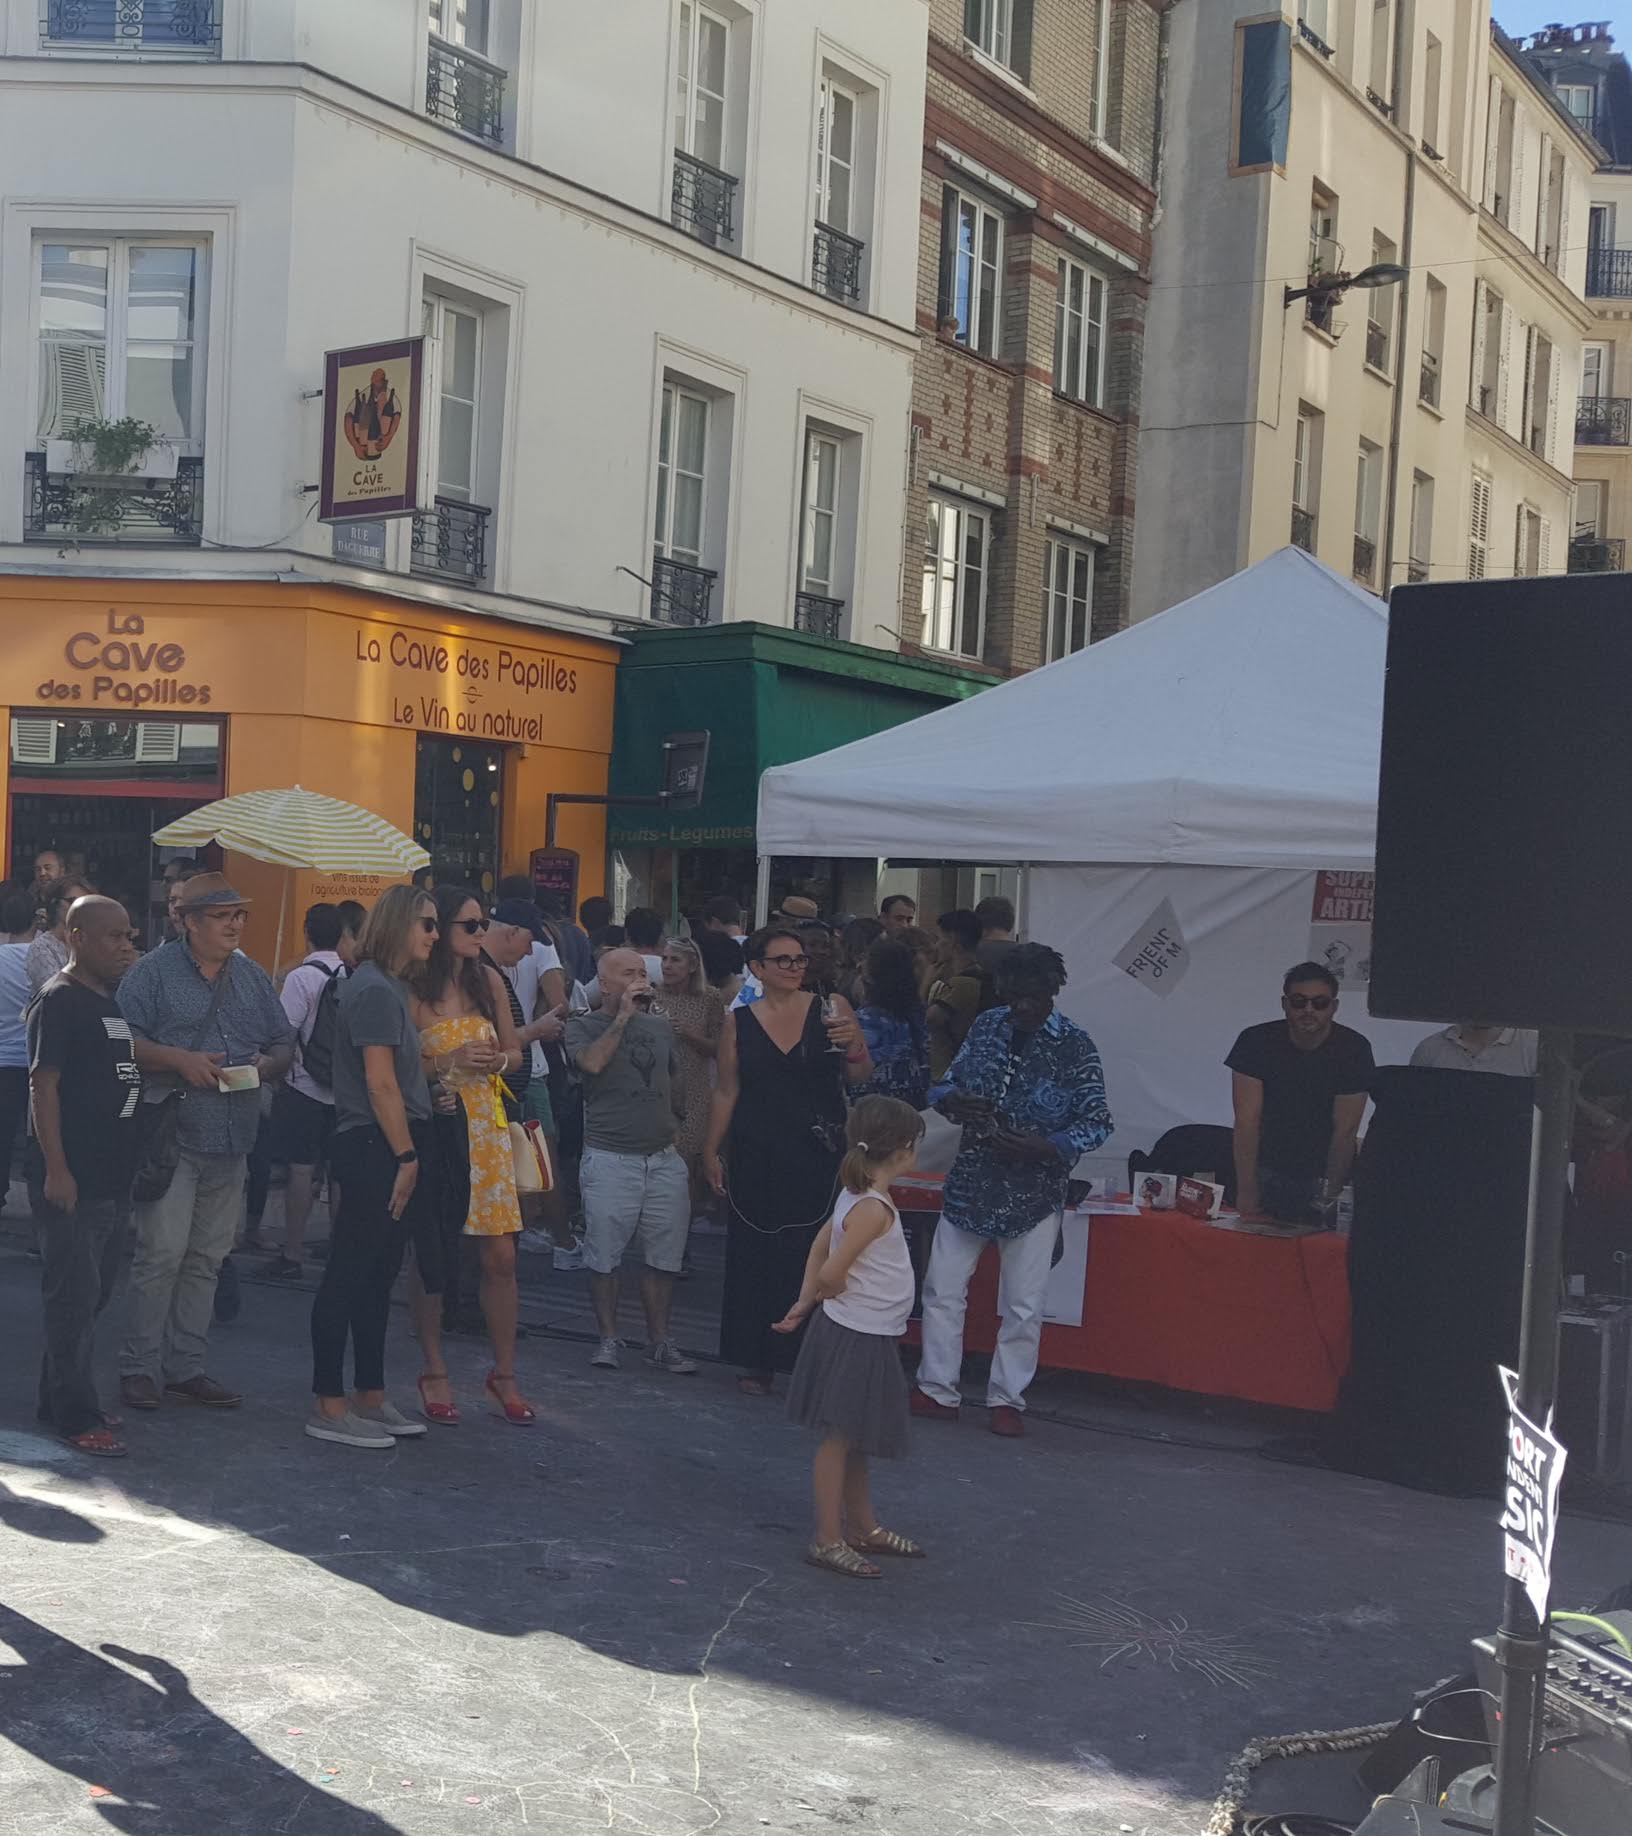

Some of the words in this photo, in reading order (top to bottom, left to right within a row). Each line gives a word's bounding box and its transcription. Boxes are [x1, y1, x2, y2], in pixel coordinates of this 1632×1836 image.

[365, 464, 377, 473] LA
[337, 540, 381, 558] DAGUERRE
[351, 527, 369, 542] RUE
[108, 608, 145, 635] La
[65, 632, 186, 673] Cave
[356, 630, 381, 663] La
[390, 631, 449, 674] Cave
[456, 649, 489, 680] des
[498, 650, 577, 694] Papilles
[37, 679, 81, 700] des
[93, 676, 212, 708] Papilles
[393, 697, 414, 724] Le
[421, 696, 450, 730] Vin
[456, 711, 477, 733] au
[482, 708, 543, 741] naturel
[1510, 1425, 1547, 1481] ORT
